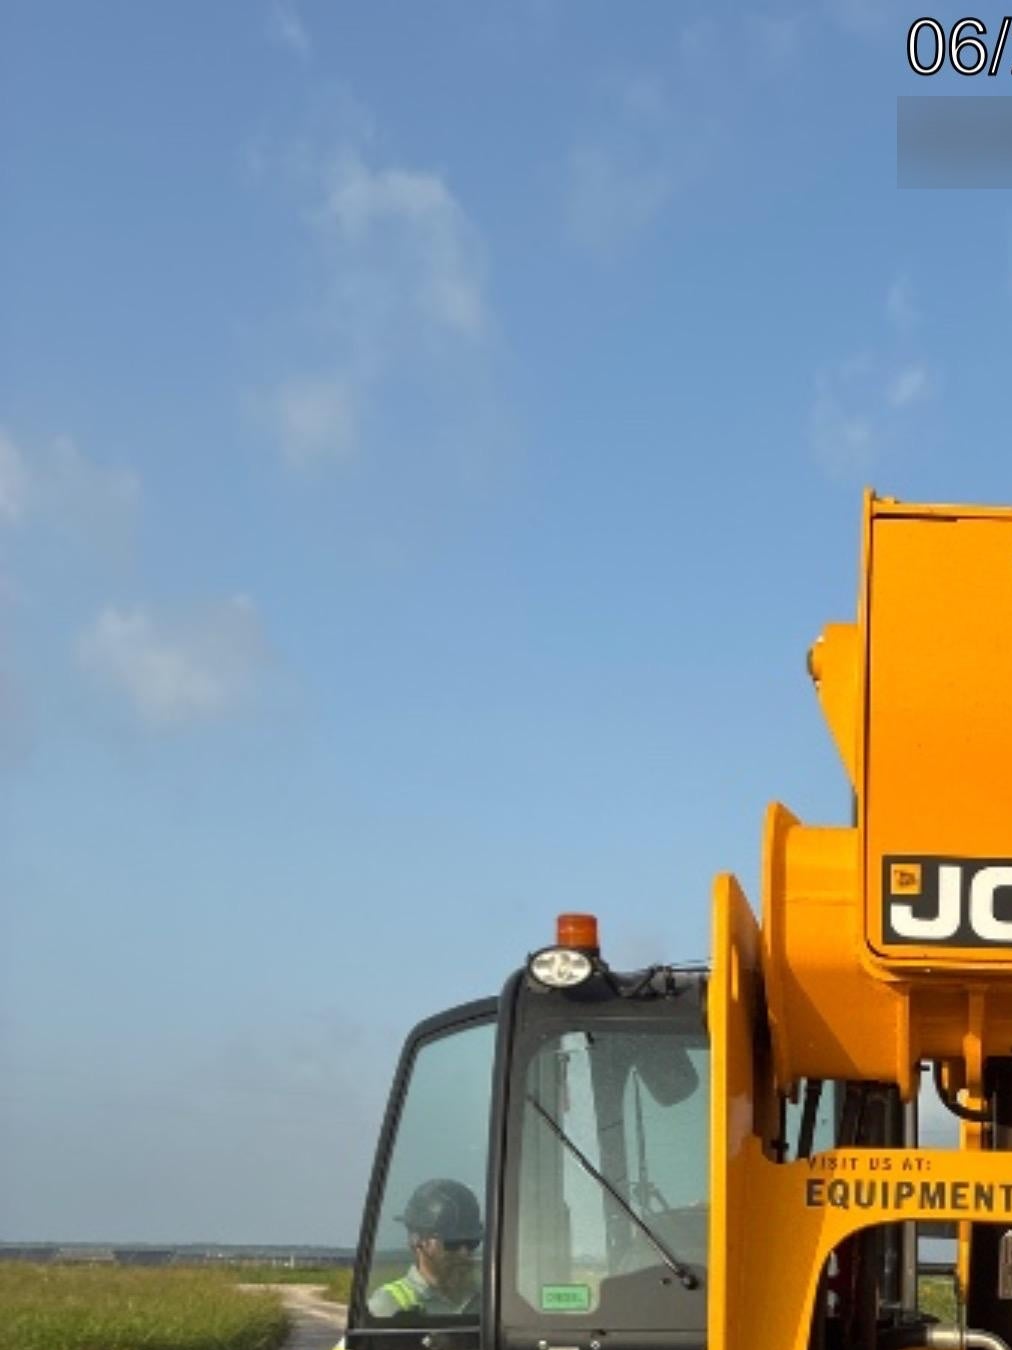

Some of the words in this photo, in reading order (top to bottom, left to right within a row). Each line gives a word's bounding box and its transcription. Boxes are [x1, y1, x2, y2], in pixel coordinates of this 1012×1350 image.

[807, 1157, 859, 1171] VISIT
[869, 1158, 893, 1171] US
[902, 1158, 932, 1171] AT:
